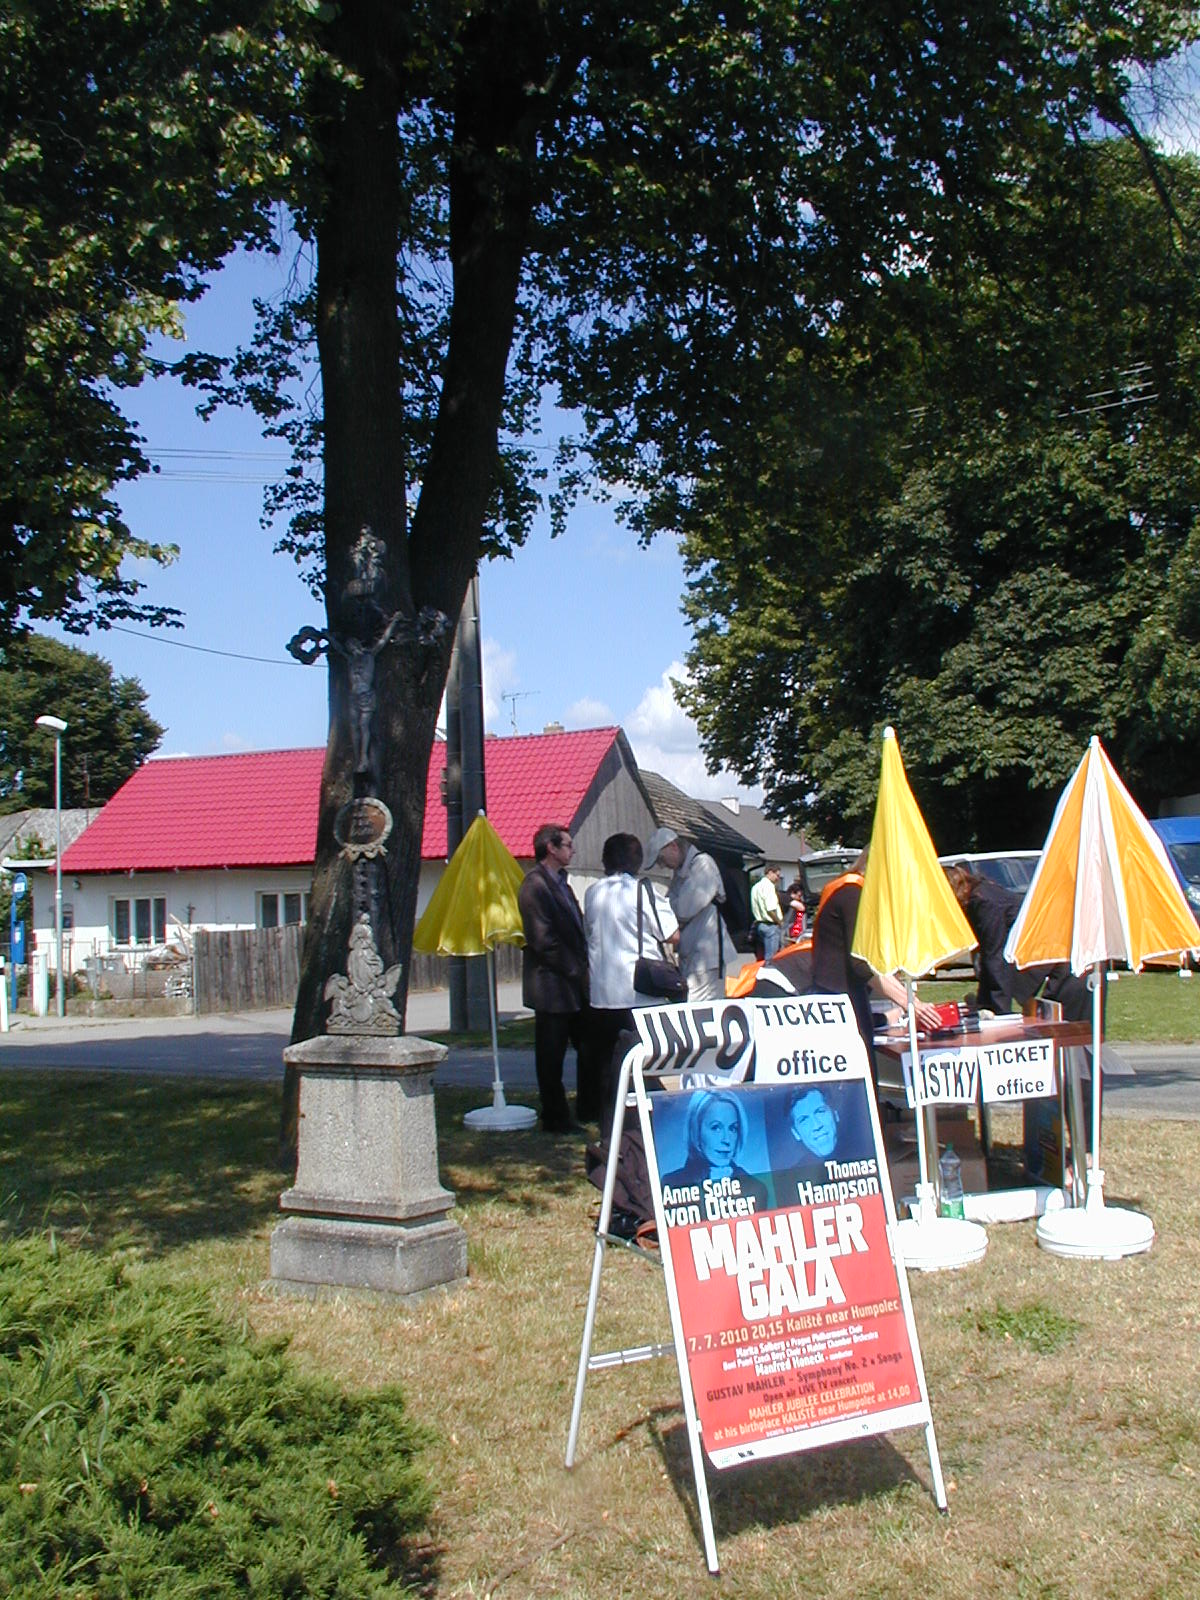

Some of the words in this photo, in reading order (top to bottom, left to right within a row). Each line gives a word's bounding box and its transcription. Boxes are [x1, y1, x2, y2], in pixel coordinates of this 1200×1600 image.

[756, 1002, 846, 1026] TICKET
[643, 1004, 750, 1070] INFO
[777, 1050, 847, 1076] office
[984, 1045, 1050, 1066] TICKET
[996, 1079, 1045, 1096] office
[824, 1159, 877, 1180] Thomas
[663, 1185, 700, 1205] Anne
[702, 1177, 741, 1198] Sofie
[797, 1177, 879, 1206] Hampson
[664, 1205, 701, 1228] von
[705, 1196, 756, 1221] Otter
[689, 1203, 869, 1281] MAHLER
[737, 1256, 847, 1321] GALA
[689, 1337, 702, 1352] 7.
[704, 1334, 717, 1349] 7.
[720, 1327, 749, 1346] 2010
[751, 1321, 784, 1339] 20,15
[786, 1312, 823, 1332] Kaliště
[825, 1310, 849, 1324] near
[850, 1299, 899, 1318] Humpolec
[706, 1385, 744, 1402] GUSTAV
[747, 1376, 785, 1392] MAHLER
[797, 1365, 843, 1382] Symphony
[844, 1361, 859, 1371] No.
[861, 1357, 868, 1368] 2
[877, 1352, 902, 1363] Songs
[755, 1361, 792, 1377] Manfred
[792, 1352, 824, 1369] Honeck
[748, 1402, 784, 1420] MAHLER
[786, 1395, 819, 1412] JUBILEE
[820, 1382, 875, 1403] CELEBRATION
[763, 1393, 784, 1403] Open
[786, 1388, 796, 1397] air
[798, 1384, 815, 1395] LIVE
[818, 1381, 828, 1389] TV
[830, 1375, 857, 1388] concert
[714, 1431, 723, 1441] at
[725, 1427, 738, 1438] his
[739, 1418, 781, 1434] birthplace
[781, 1406, 817, 1424] KALIŠTĚ
[818, 1404, 837, 1417] near
[837, 1395, 876, 1412] Humpolec
[877, 1393, 886, 1402] at
[888, 1385, 911, 1401] 14,00
